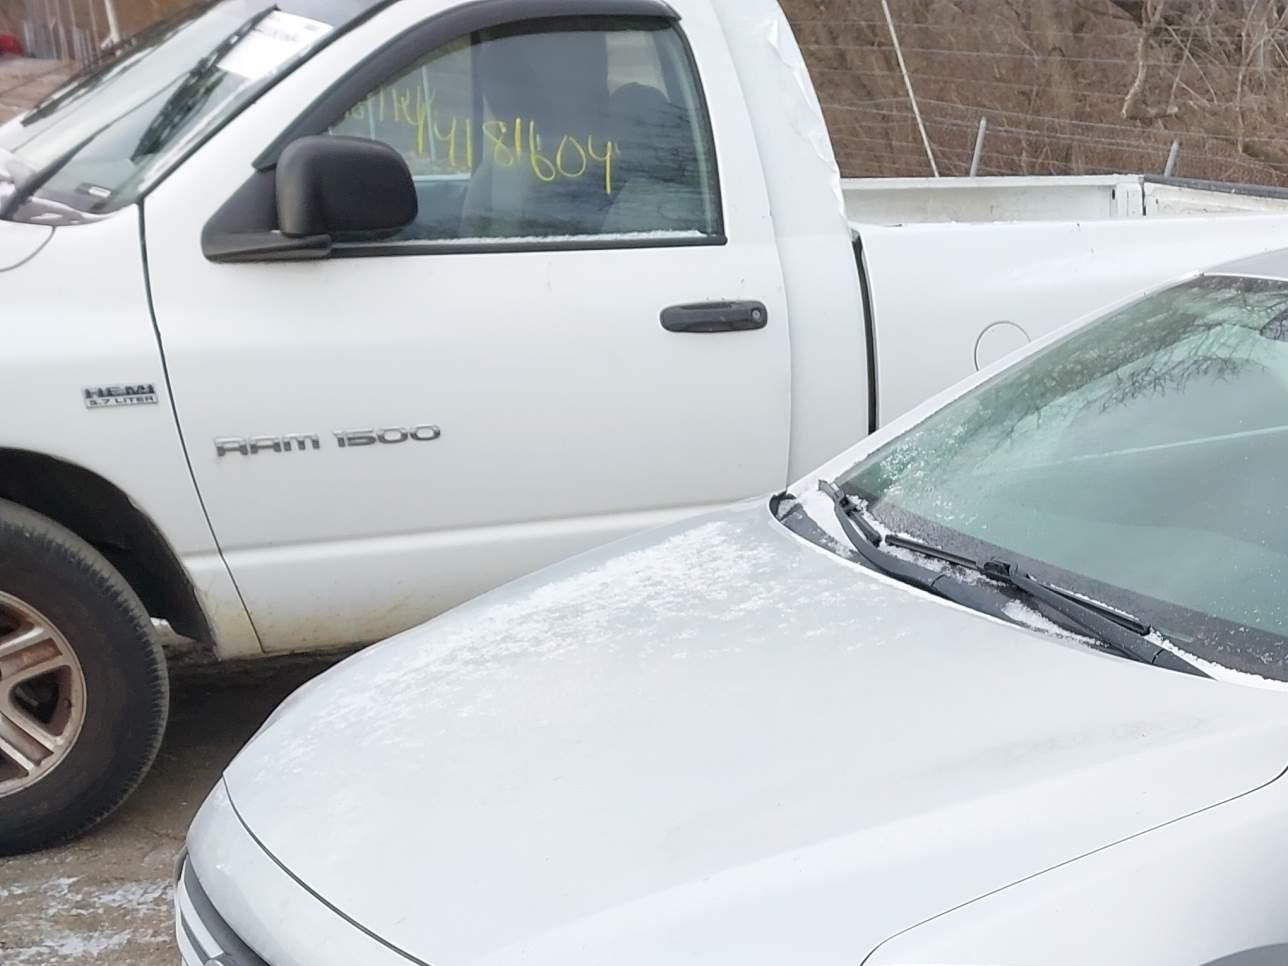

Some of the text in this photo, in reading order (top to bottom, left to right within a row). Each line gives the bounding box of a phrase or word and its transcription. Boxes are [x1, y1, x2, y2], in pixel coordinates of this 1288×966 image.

[401, 93, 612, 195] 44181604
[84, 385, 155, 399] HEMI
[115, 395, 154, 404] LITER
[215, 424, 441, 457] RAM 1500
